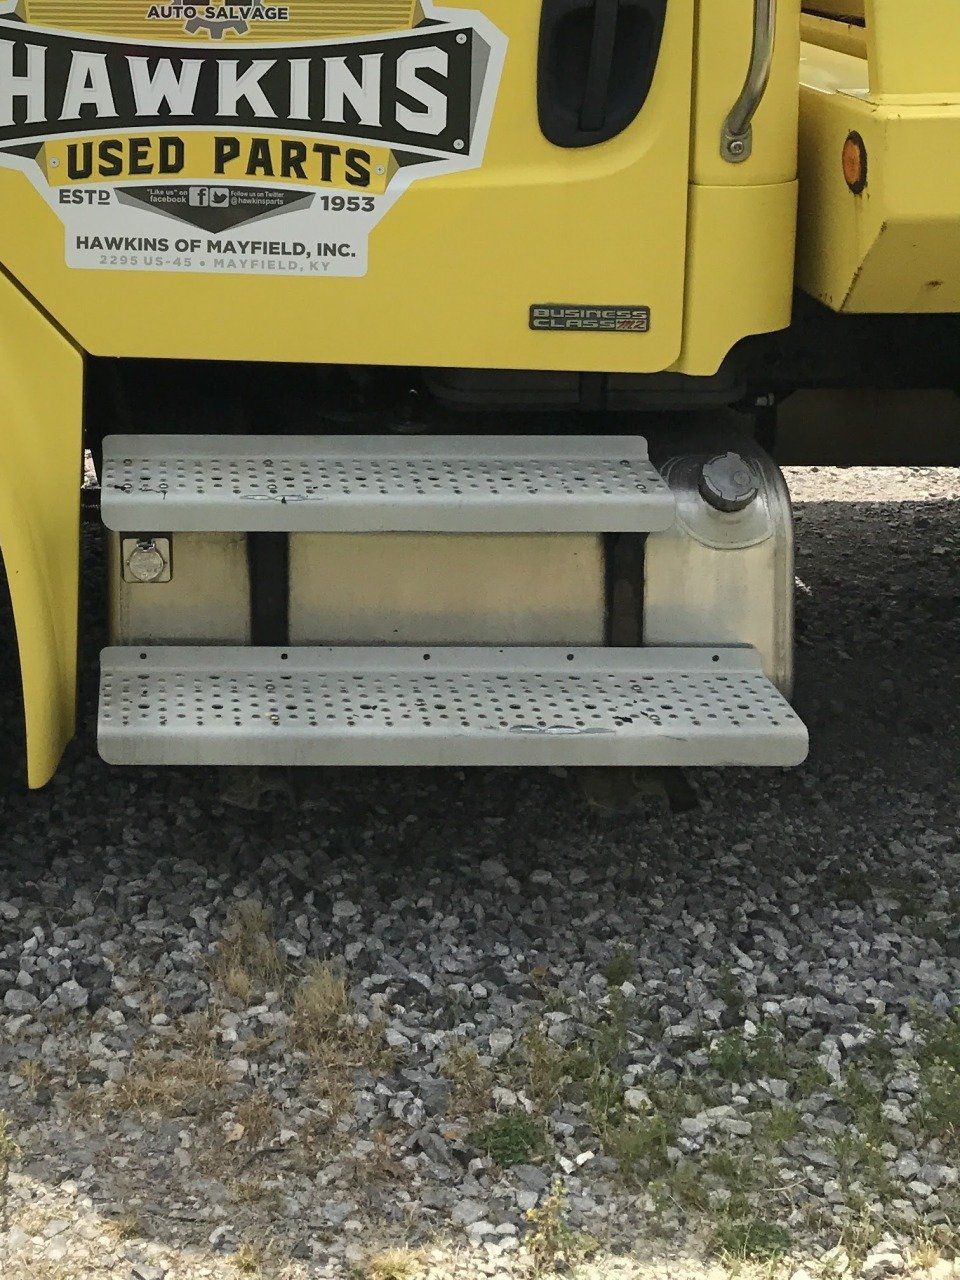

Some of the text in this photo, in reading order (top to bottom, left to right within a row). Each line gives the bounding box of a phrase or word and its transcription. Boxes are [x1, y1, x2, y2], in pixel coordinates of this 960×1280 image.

[147, 6, 288, 20] AUTO SALVAGE
[66, 136, 372, 187] USED PARTS
[59, 188, 111, 205] ESTD
[149, 195, 187, 203] facebook
[230, 197, 284, 206] @hawkinsparts
[320, 195, 375, 212] 1953
[76, 236, 356, 259] HAWKINS OF MAYFIELD, INC.
[99, 255, 331, 272] 2295 US-45 MAYFIELD, KY
[533, 308, 648, 319] BUSINESS
[533, 319, 615, 329] CLASS
